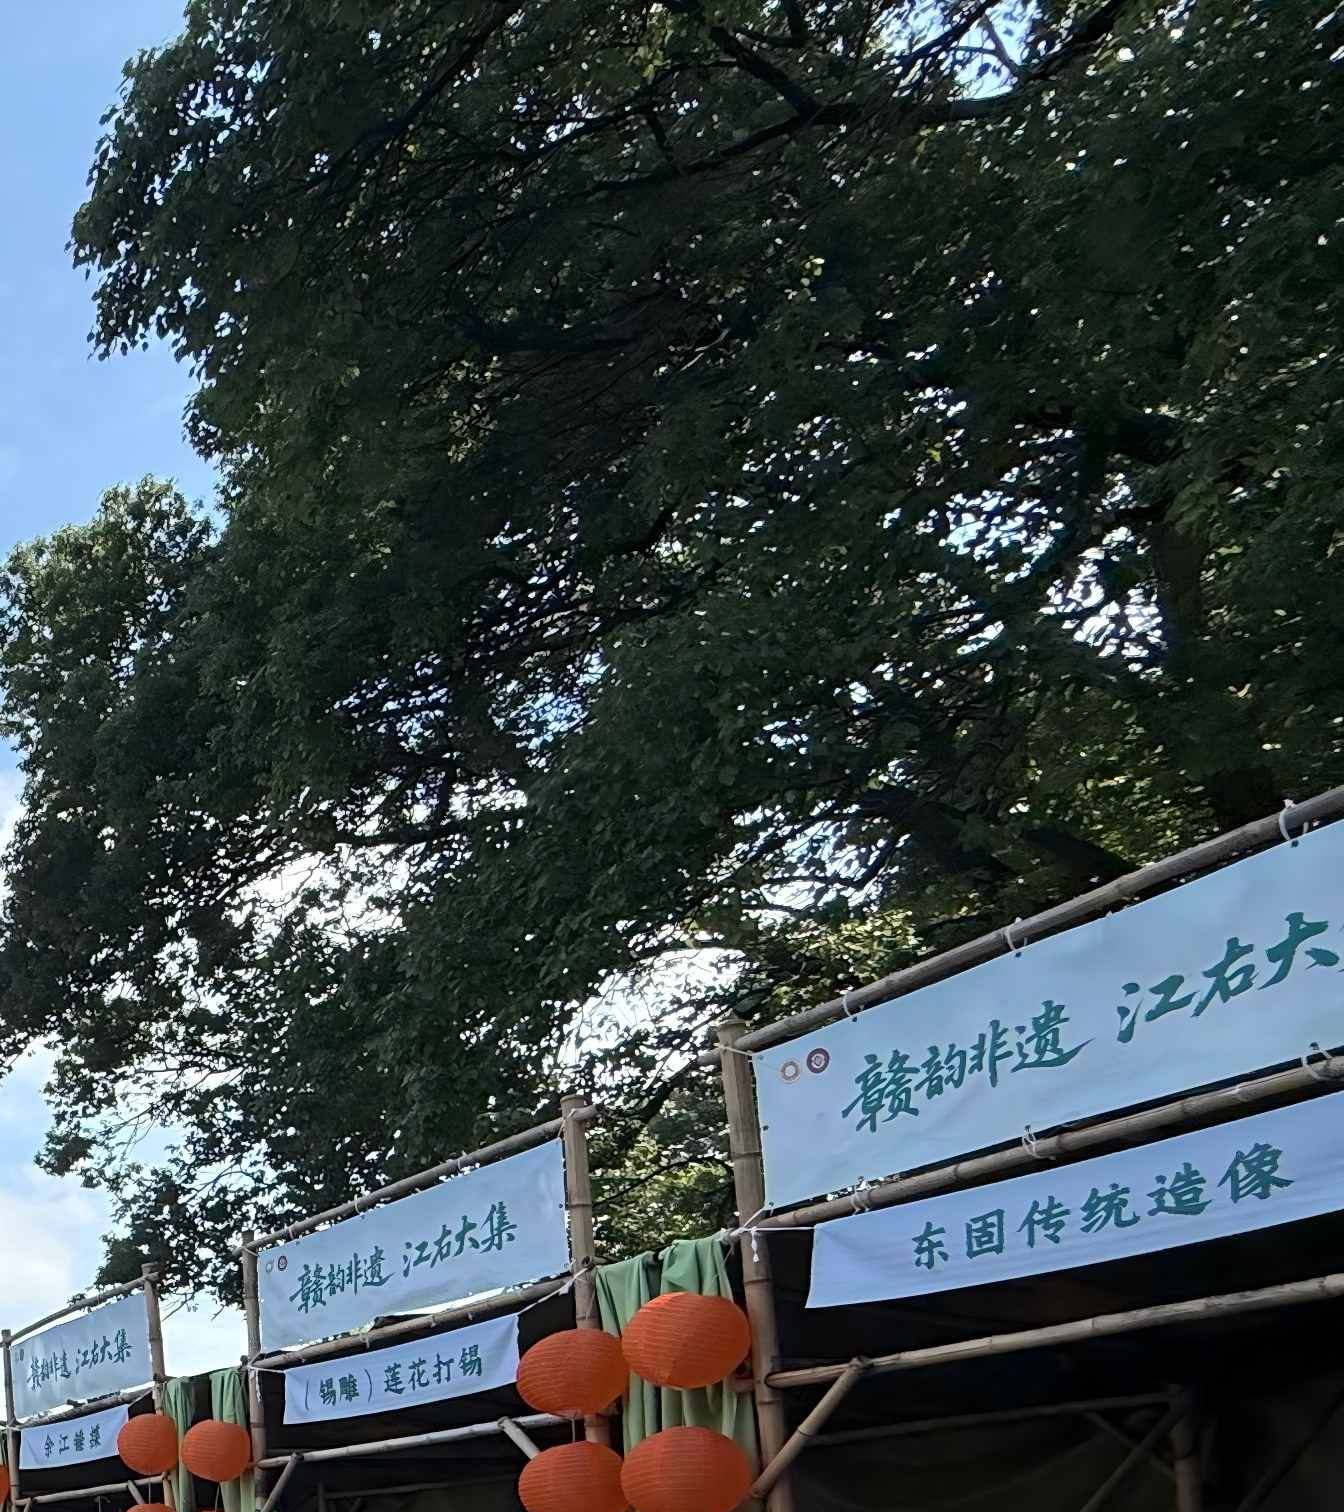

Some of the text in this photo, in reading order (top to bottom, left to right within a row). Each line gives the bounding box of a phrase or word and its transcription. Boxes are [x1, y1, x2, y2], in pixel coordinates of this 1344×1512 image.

[842, 911, 1344, 1133] 赣韵非遗 江右大
[289, 1201, 519, 1314] 赣韵非遗 江右大集
[912, 1142, 1294, 1270] 东固传统造像
